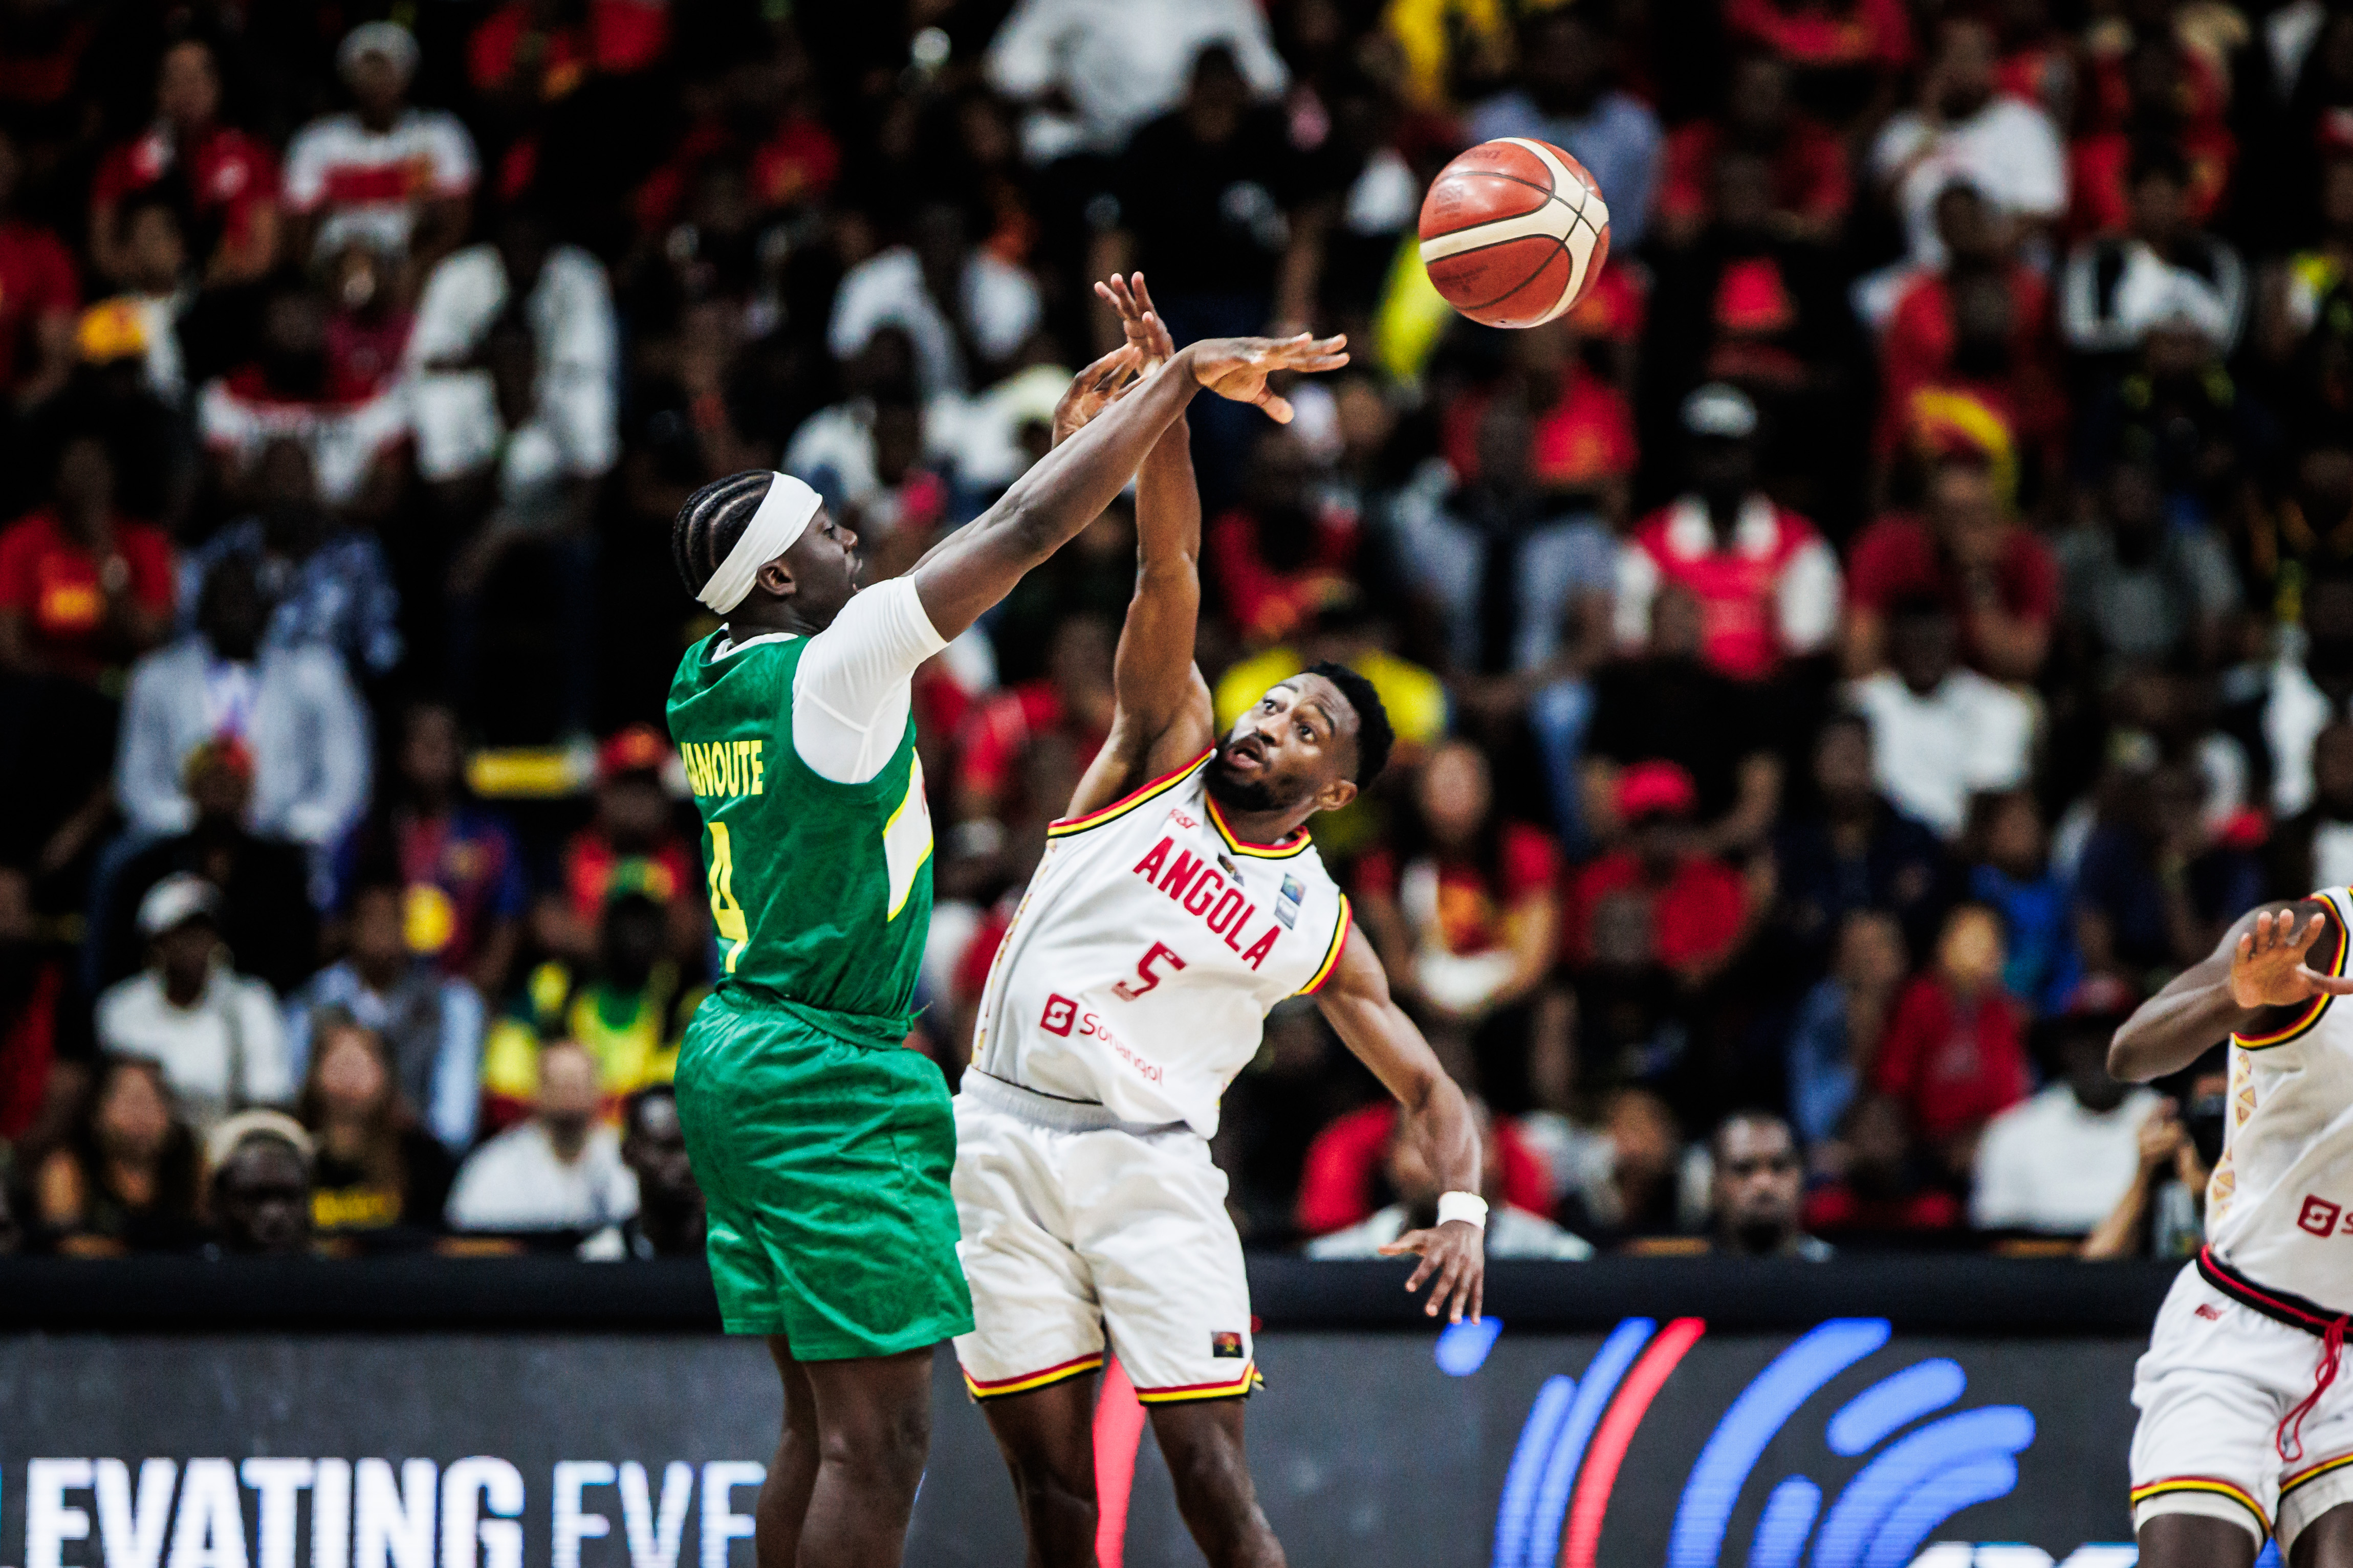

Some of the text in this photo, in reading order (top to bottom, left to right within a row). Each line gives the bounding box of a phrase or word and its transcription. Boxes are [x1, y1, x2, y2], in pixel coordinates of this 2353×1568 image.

[708, 822, 749, 973] 4
[1132, 835, 1281, 971] ANGOLA
[1111, 940, 1187, 1002] 5
[0, 1455, 525, 1568] EVATING
